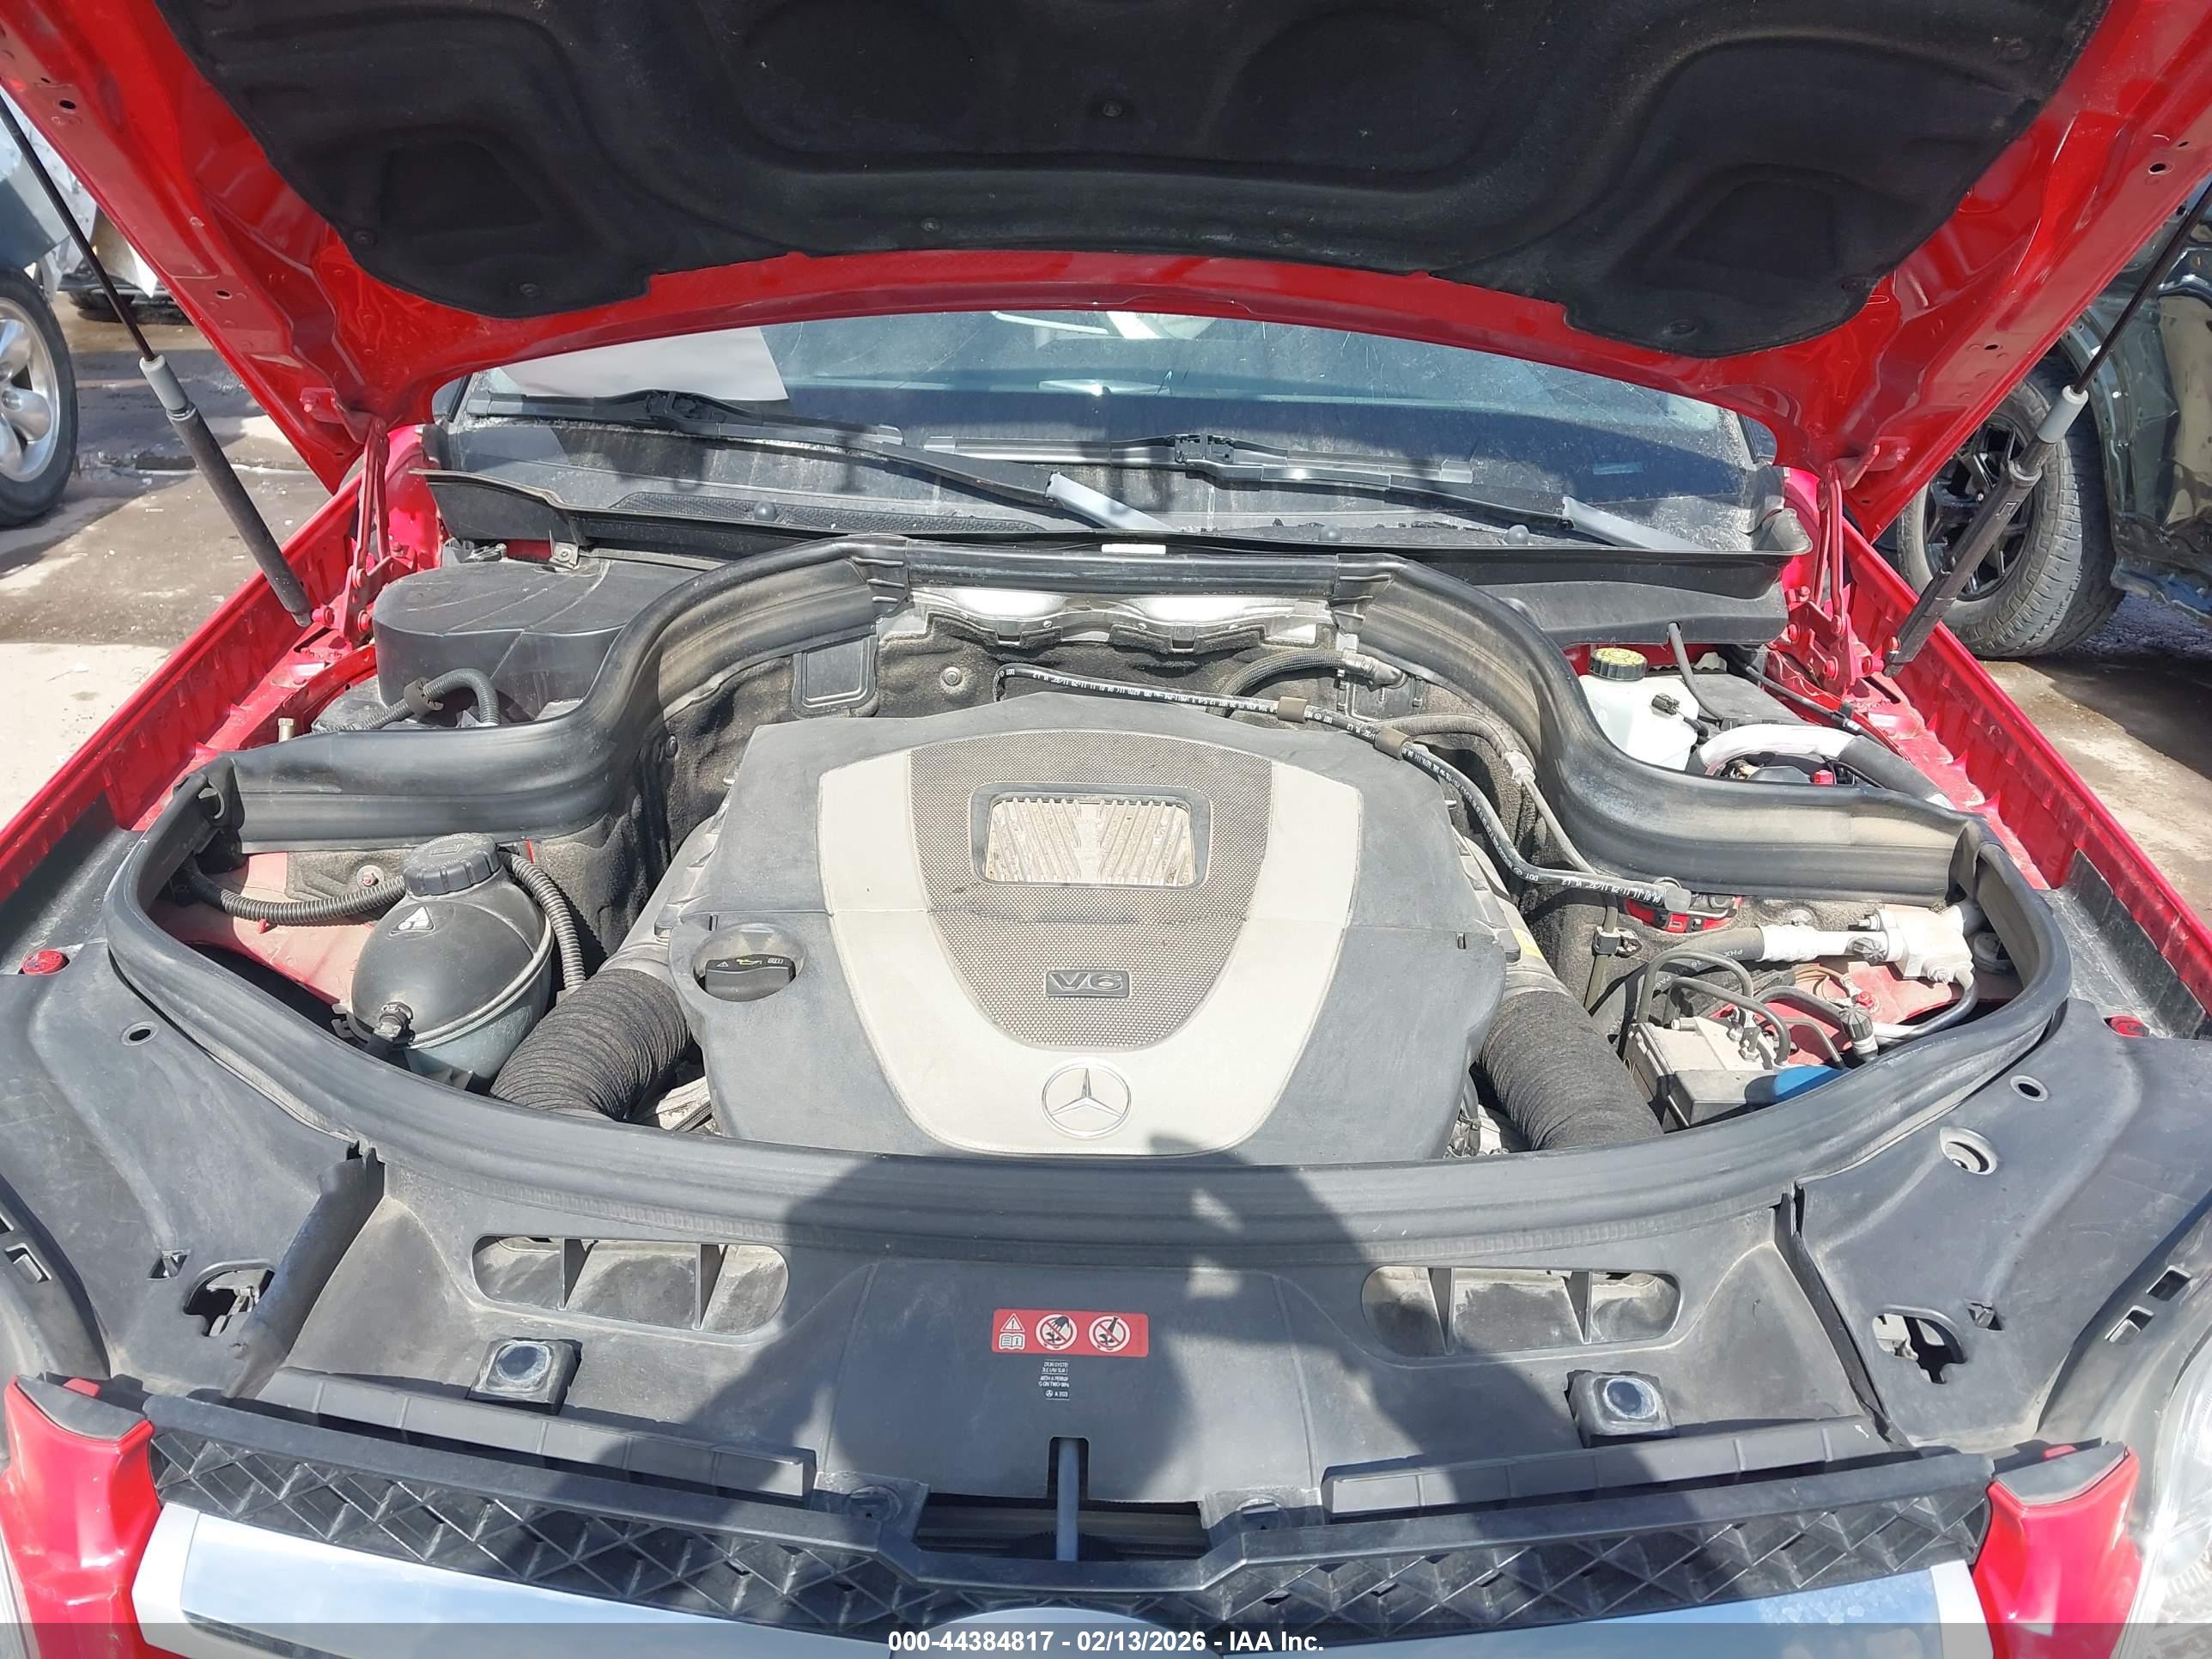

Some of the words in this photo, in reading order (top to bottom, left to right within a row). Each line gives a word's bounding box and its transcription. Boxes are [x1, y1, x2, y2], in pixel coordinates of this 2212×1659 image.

[1524, 872, 1540, 882] DOT
[1723, 948, 1744, 957] PHX
[1048, 971, 1122, 991] V6
